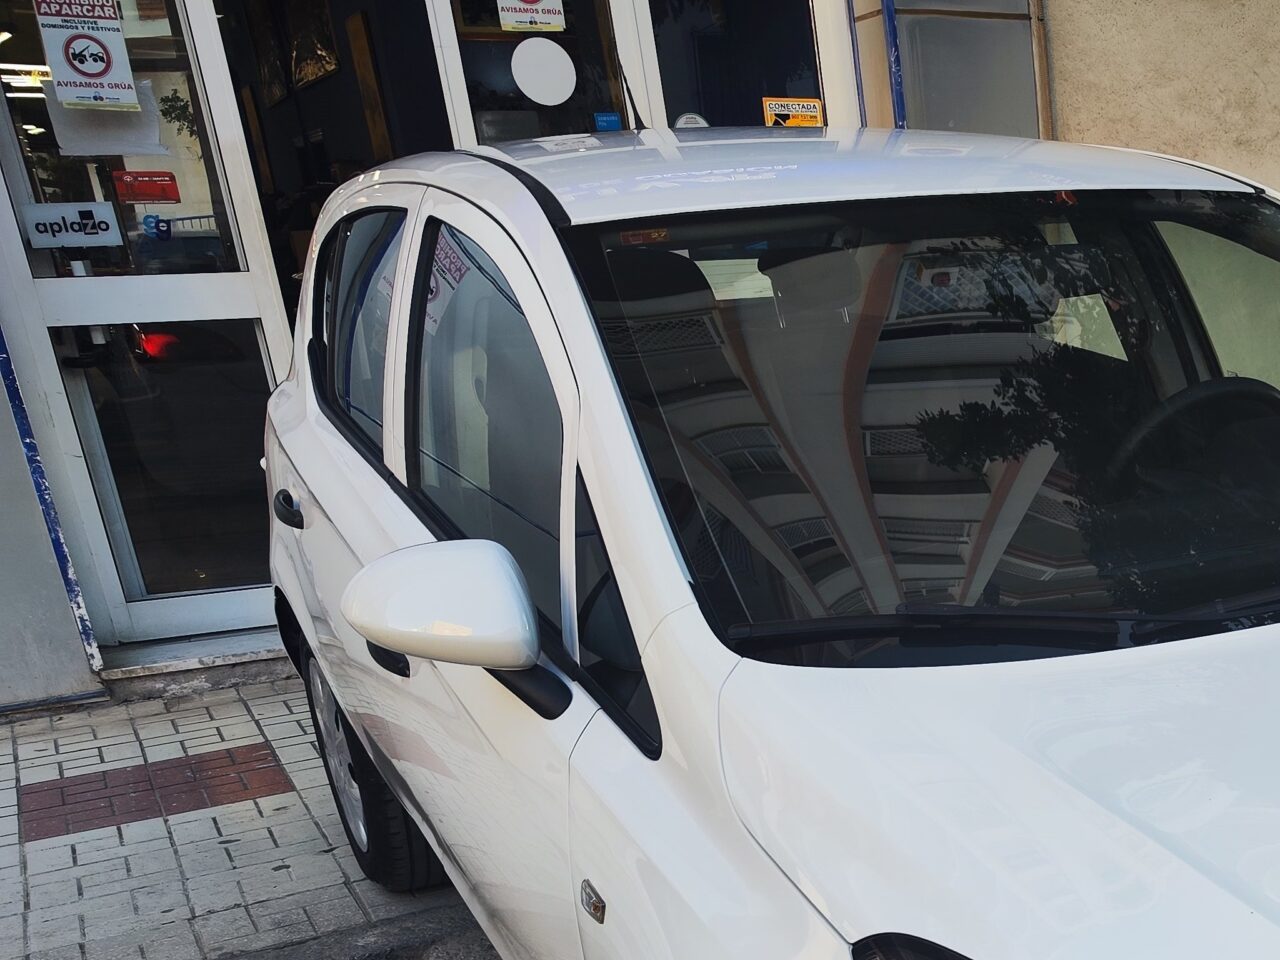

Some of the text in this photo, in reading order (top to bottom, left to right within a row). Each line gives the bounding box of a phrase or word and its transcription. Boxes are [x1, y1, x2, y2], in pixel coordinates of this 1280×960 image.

[40, 4, 116, 18] APARCAR
[501, 6, 562, 16] AVISAMOS GRÚA
[56, 81, 134, 90] AVISAMOS GRÚA
[35, 214, 110, 238] aplazo
